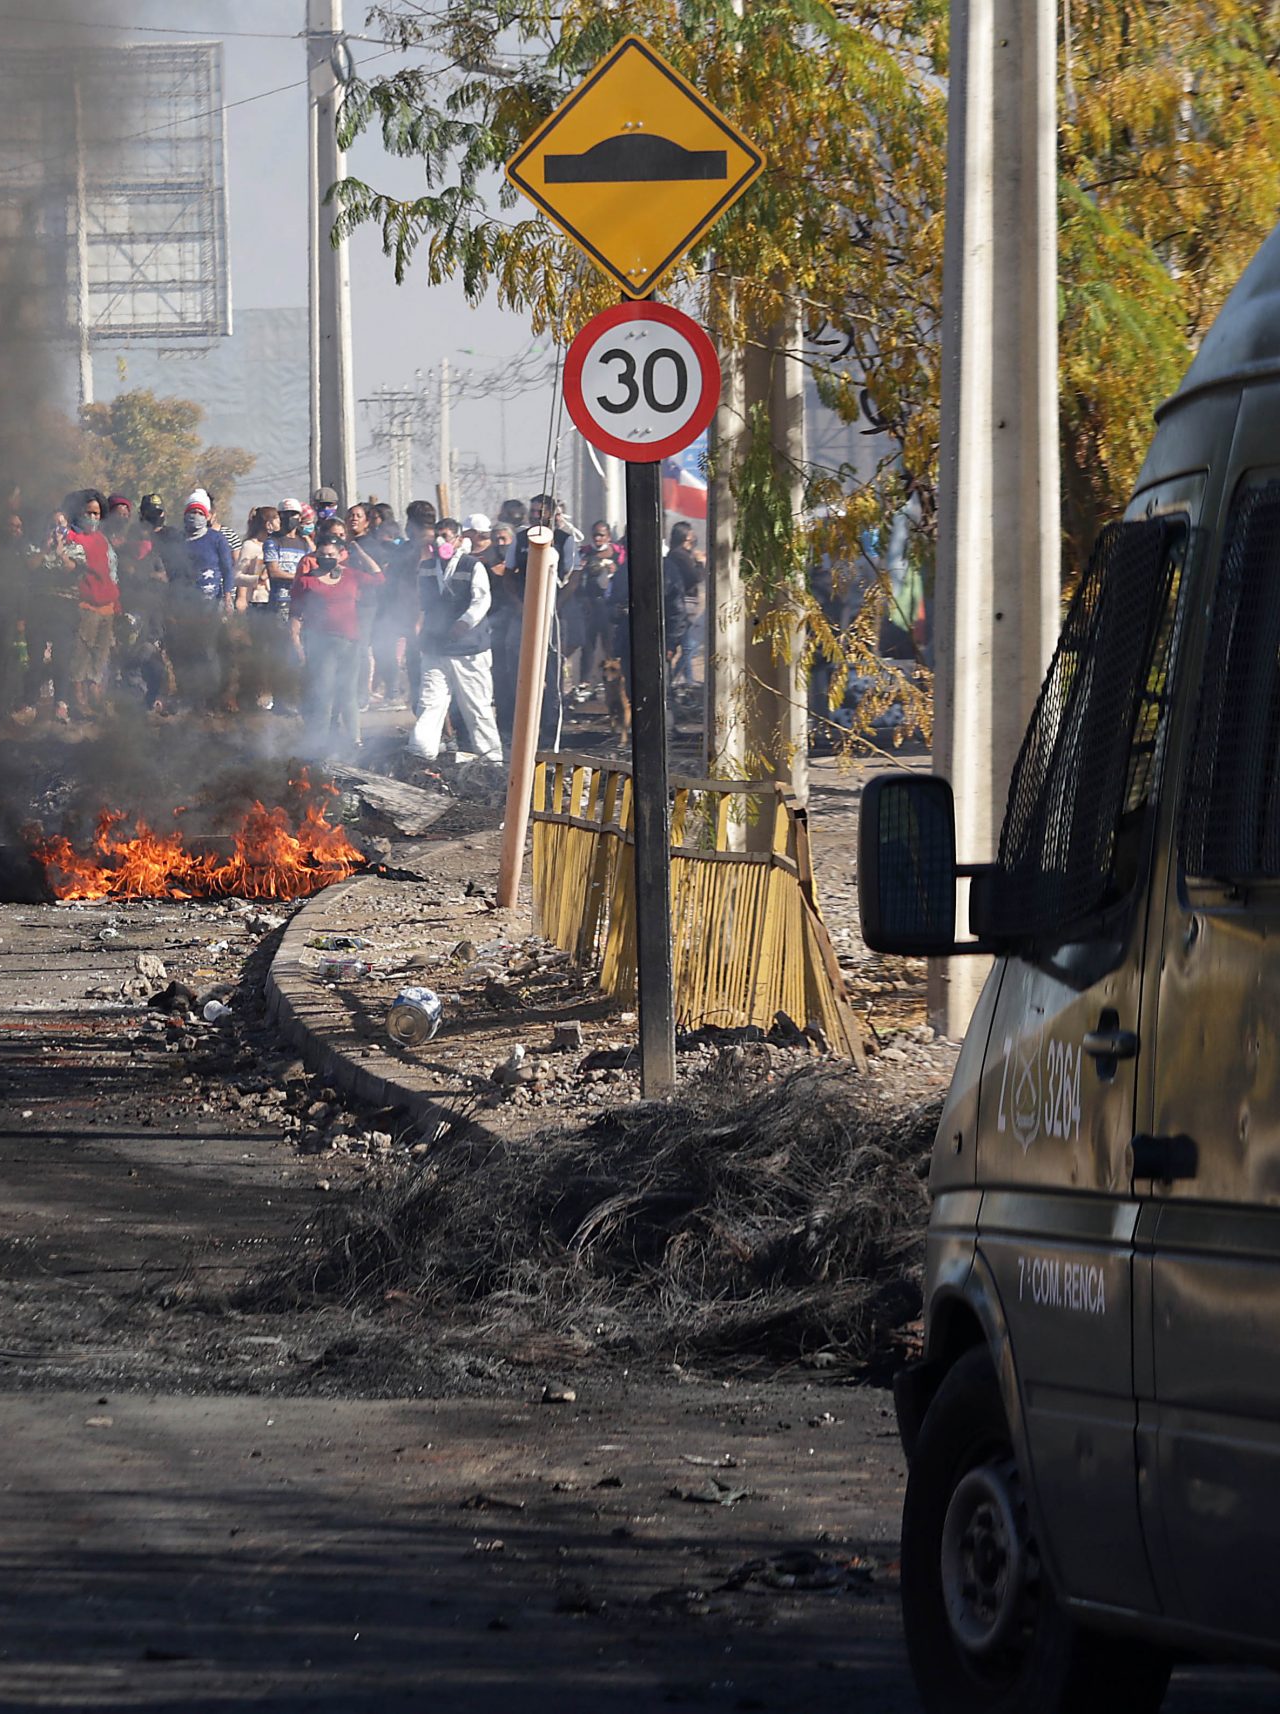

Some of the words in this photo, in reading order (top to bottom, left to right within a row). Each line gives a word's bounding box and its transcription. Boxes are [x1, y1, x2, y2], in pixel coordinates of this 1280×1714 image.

[596, 348, 688, 415] 30
[997, 1037, 1013, 1133] Z
[1044, 1038, 1082, 1142] 3264
[1032, 1256, 1062, 1307] COM.
[1064, 1260, 1106, 1315] RENCA
